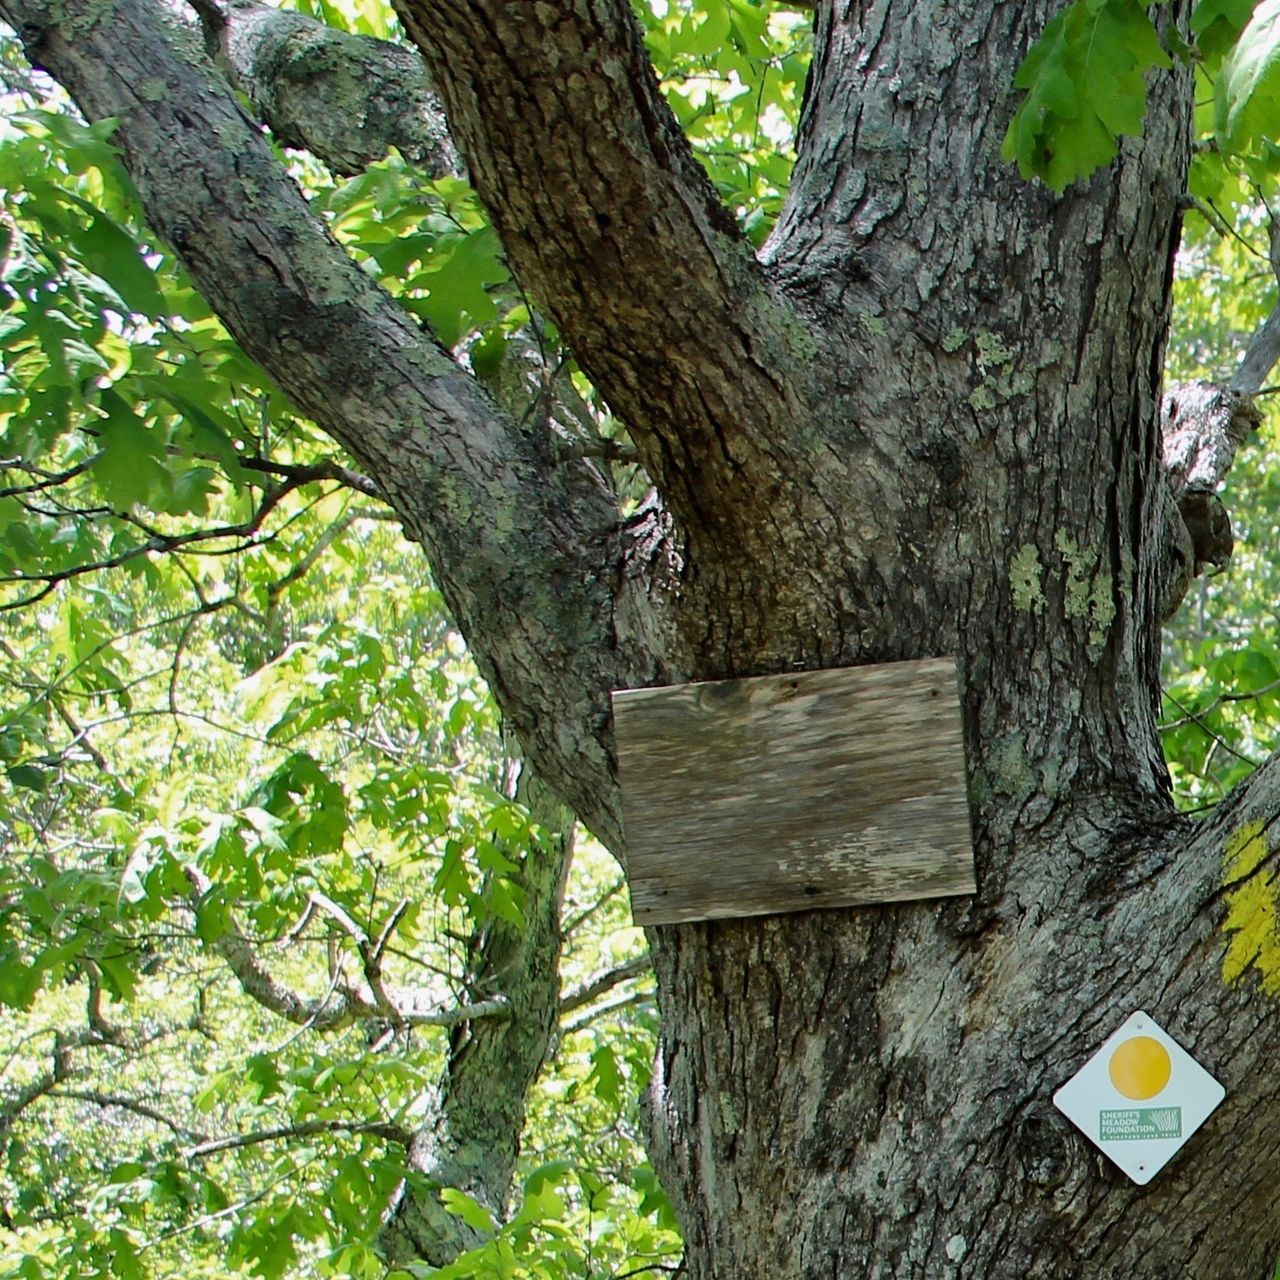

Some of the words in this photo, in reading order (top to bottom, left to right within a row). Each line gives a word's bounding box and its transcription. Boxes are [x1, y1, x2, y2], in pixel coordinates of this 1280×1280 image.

[1102, 1111, 1140, 1119] SHERIFF'S
[1102, 1118, 1139, 1126] MEADOW
[1102, 1125, 1155, 1134] FOUNDATION
